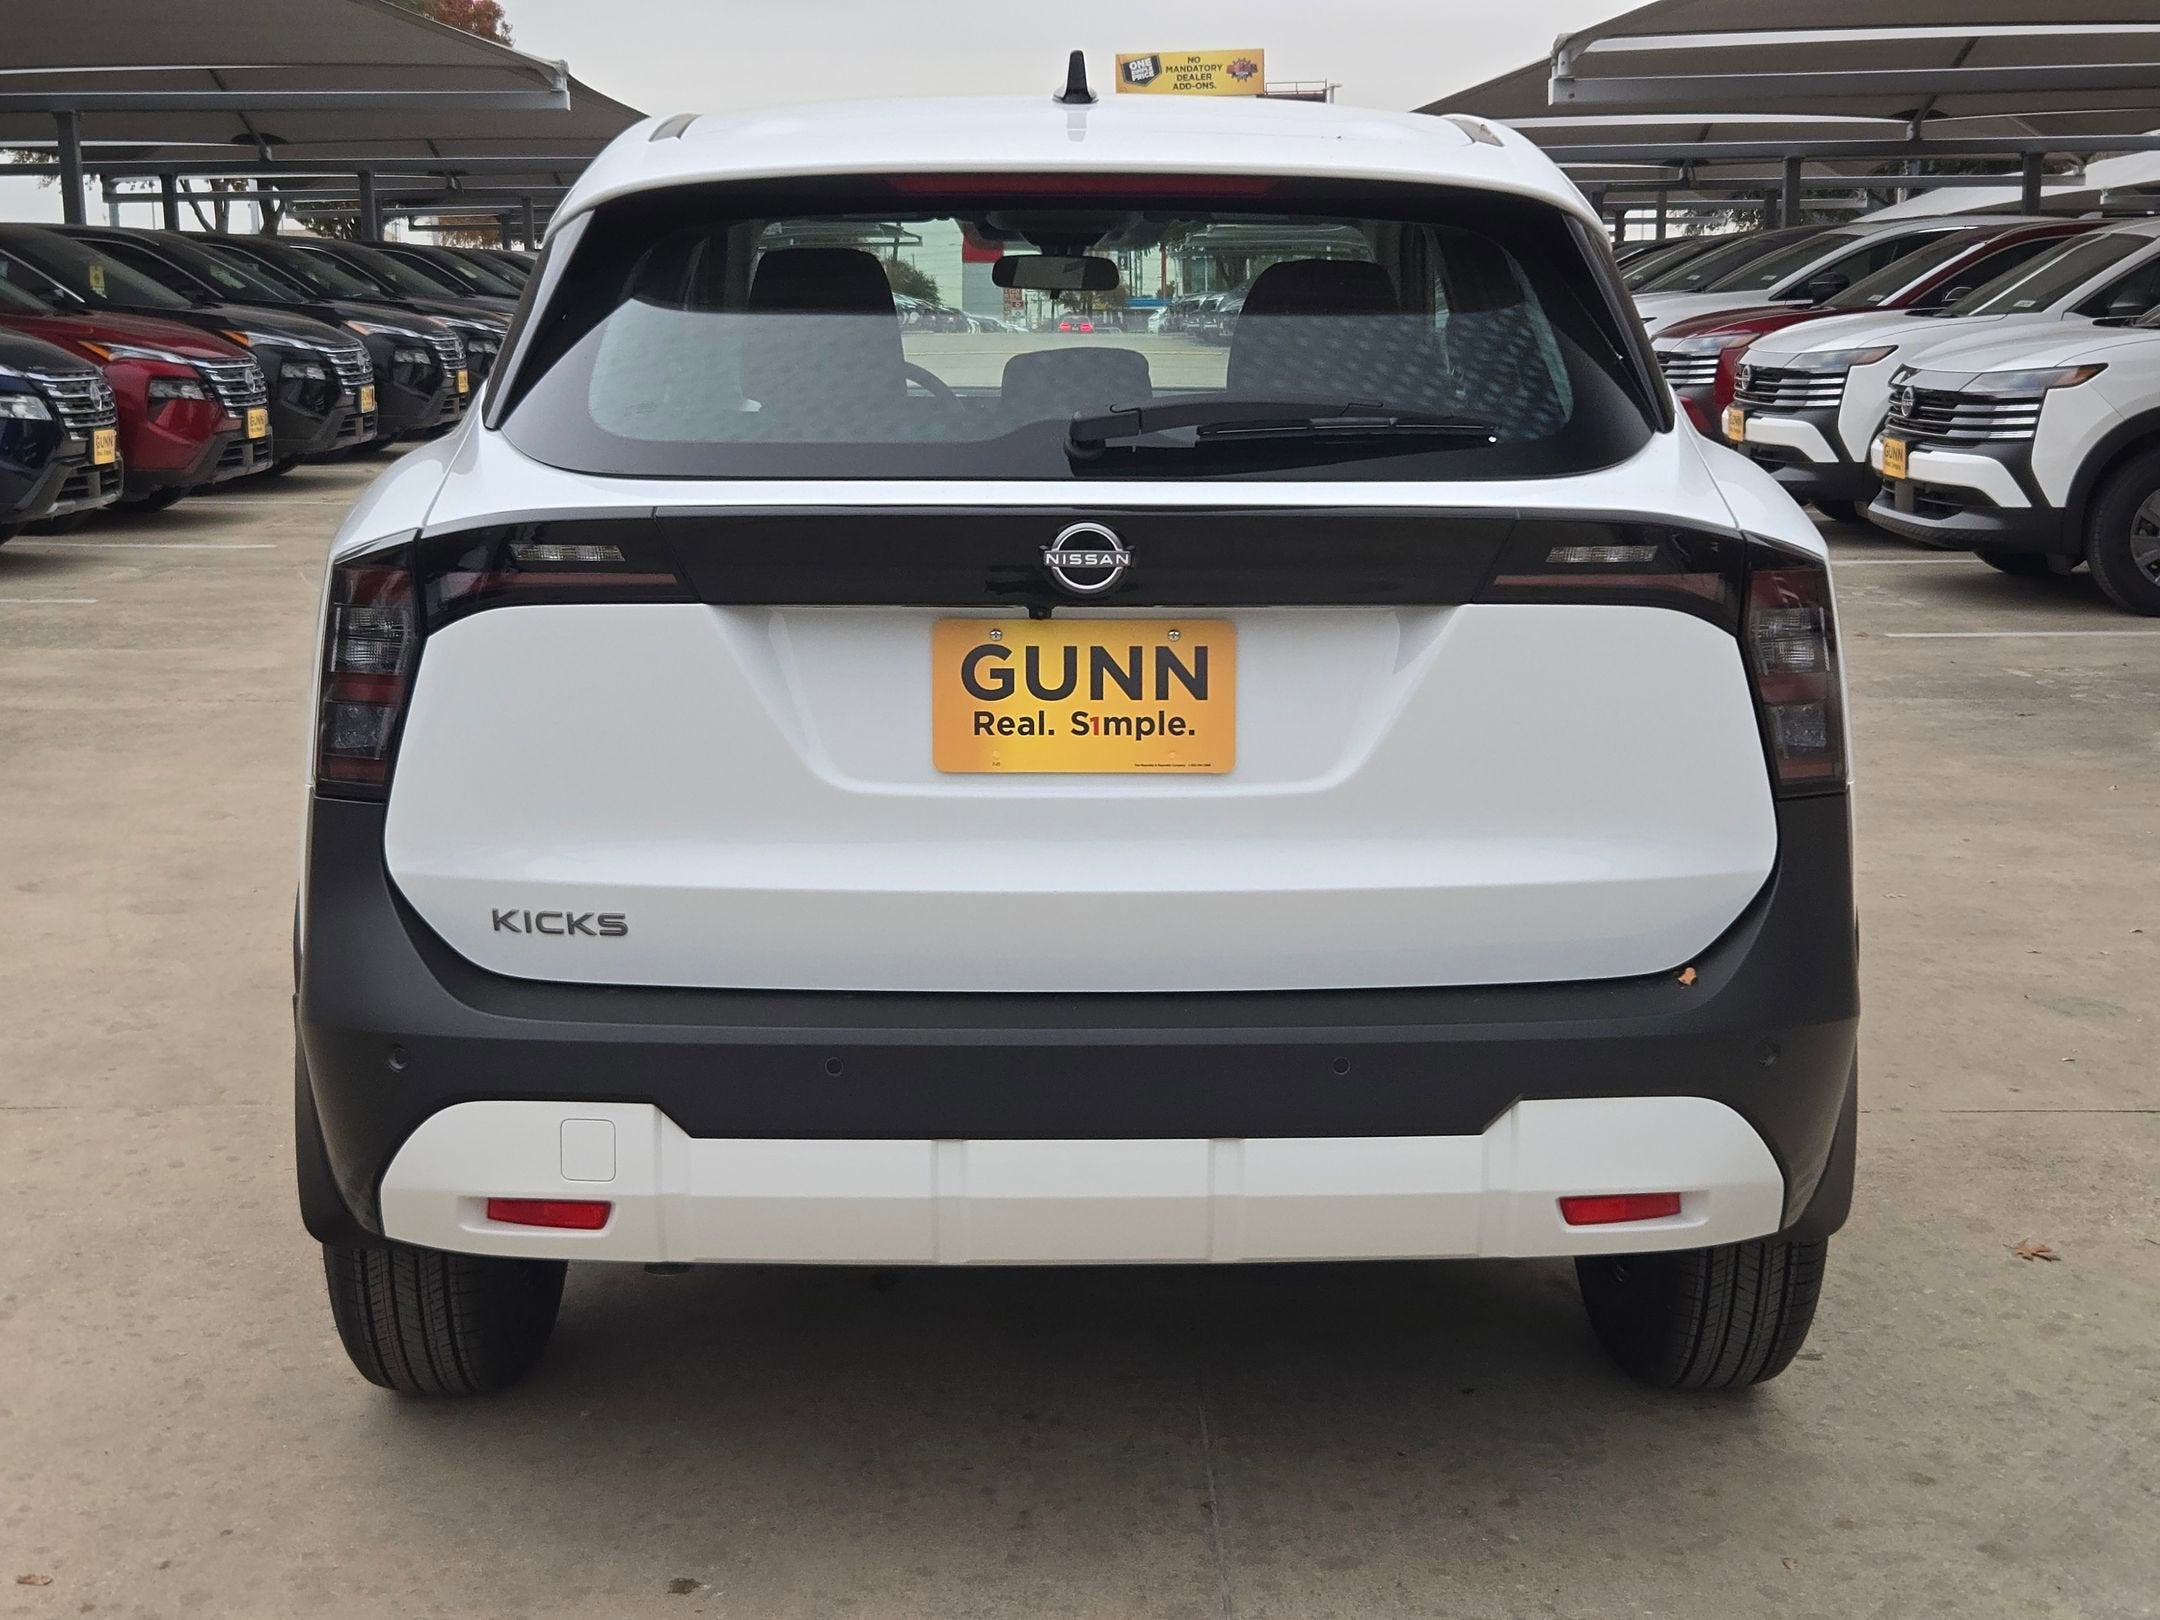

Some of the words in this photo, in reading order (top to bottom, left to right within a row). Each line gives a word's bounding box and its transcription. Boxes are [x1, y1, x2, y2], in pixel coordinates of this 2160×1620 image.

[1129, 57, 1153, 70] ONE
[1187, 56, 1201, 64] NO
[1165, 64, 1223, 73] MANDATORY
[1176, 73, 1212, 82] DEALER
[1172, 82, 1217, 91] ADD-ONS.
[1046, 553, 1129, 565] NISSAN
[961, 643, 1208, 701] GUNN
[973, 710, 1055, 736] Real.
[492, 908, 629, 936] KICKS
